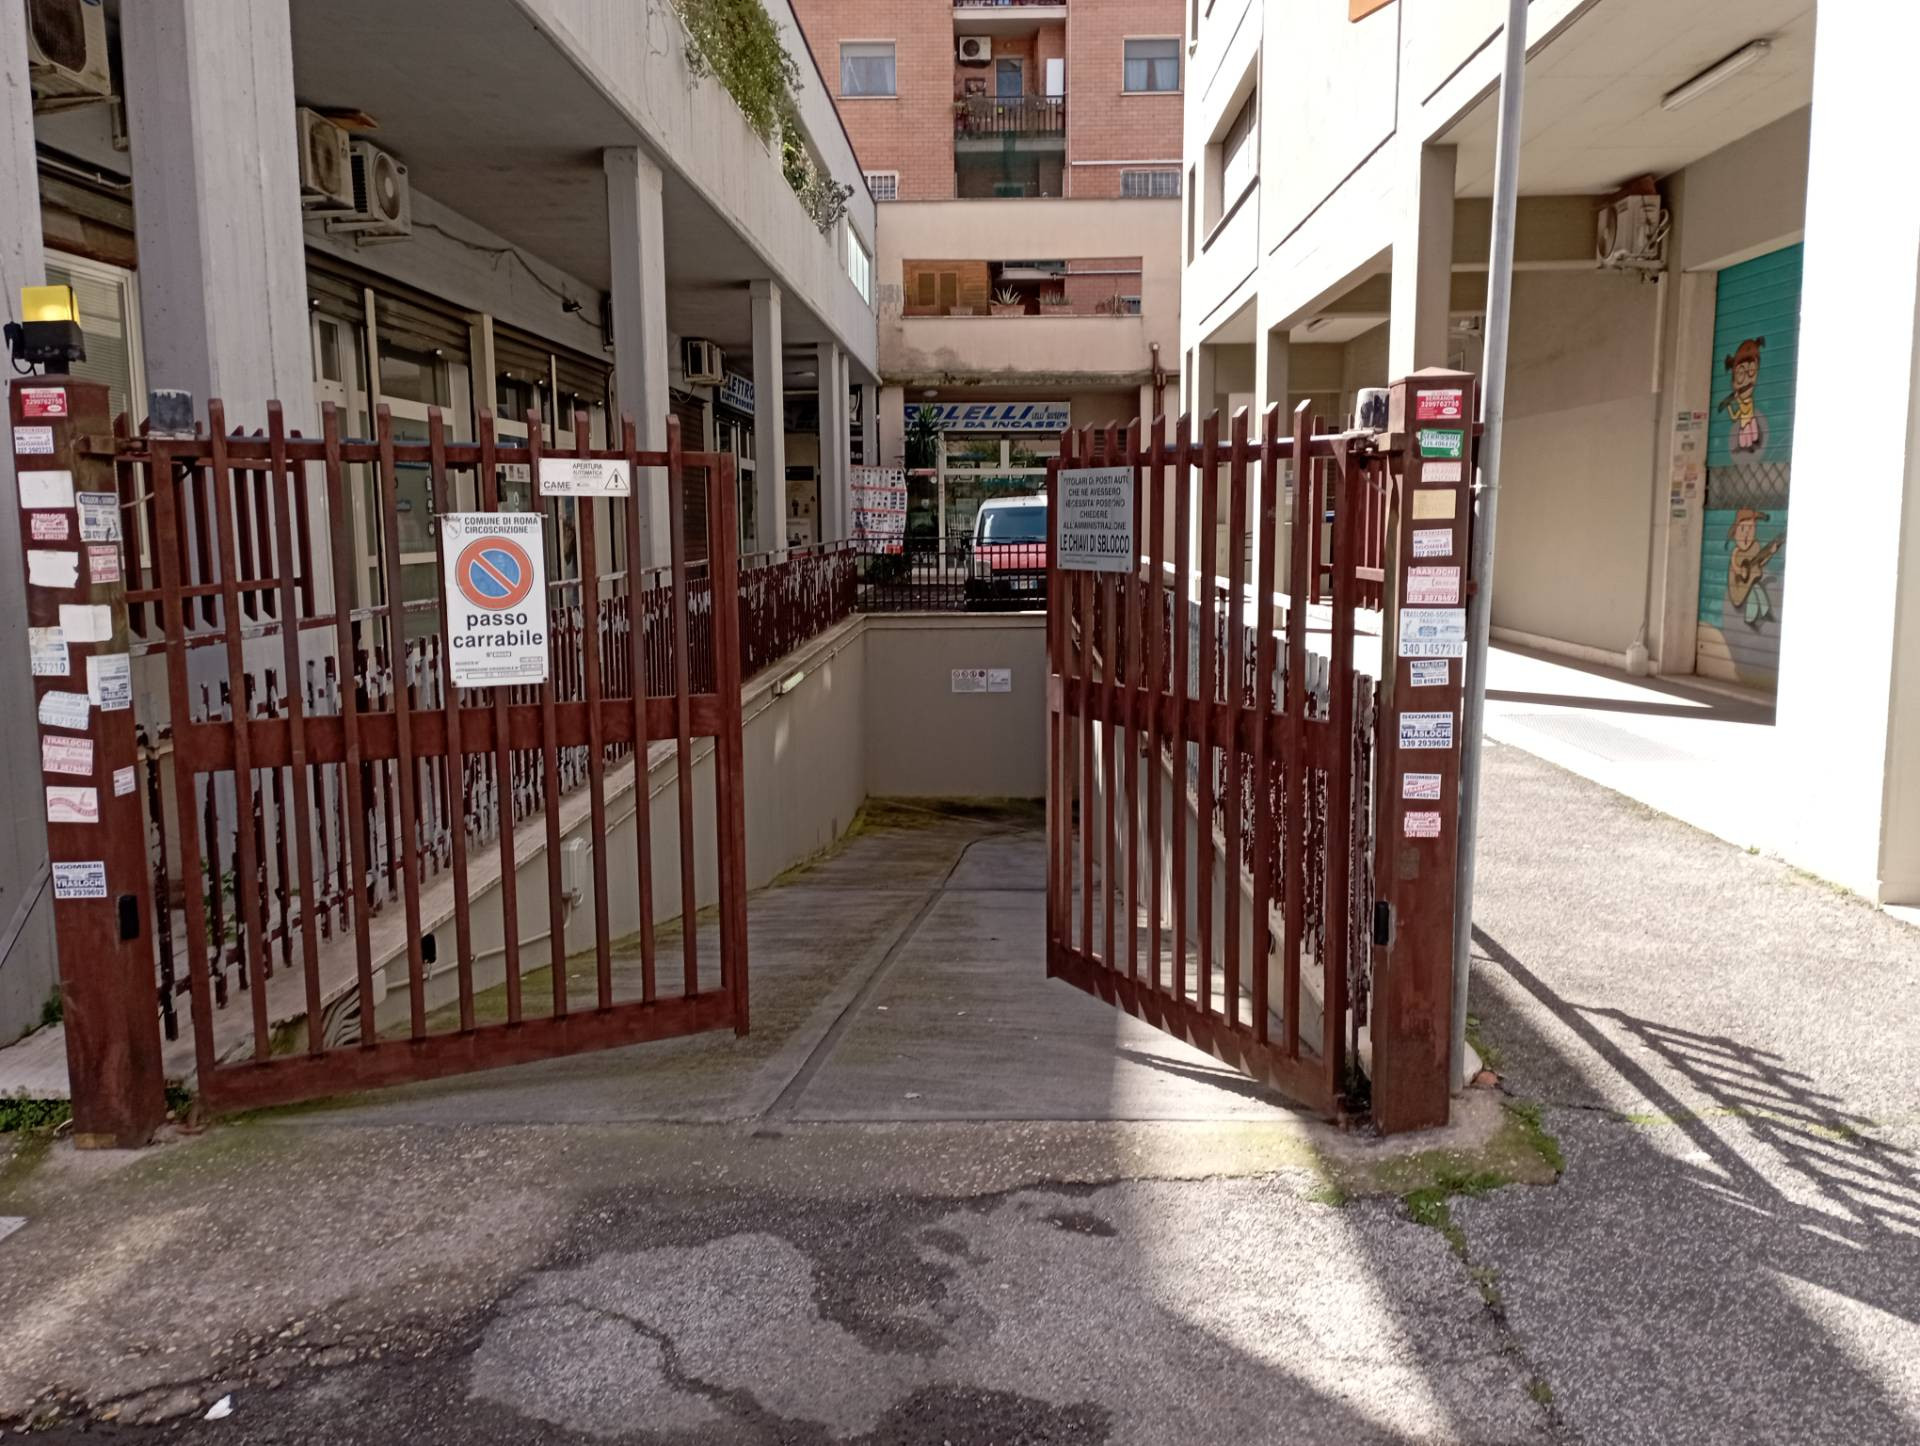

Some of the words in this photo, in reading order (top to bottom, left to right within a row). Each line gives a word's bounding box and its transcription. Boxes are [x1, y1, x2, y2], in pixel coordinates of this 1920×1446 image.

[964, 420, 986, 429] DA
[992, 420, 1068, 429] INCASSO
[572, 462, 603, 470] APERTURA
[1096, 475, 1113, 485] POSTI
[543, 480, 571, 490] CAME
[1068, 488, 1079, 497] CHE
[1090, 486, 1122, 497] AVESSERO
[1079, 510, 1108, 519] CHIEDERE
[464, 516, 502, 526] COMUNE
[503, 517, 512, 526] DI
[513, 516, 539, 526] ROMA
[1063, 521, 1127, 530] ALL'AMMINISTRAZIONE
[464, 525, 529, 534] CIRCOSCRIZIONE
[1060, 533, 1068, 552] LE
[1068, 533, 1089, 552] CHIAVI
[1089, 533, 1096, 553] DI
[1097, 534, 1130, 554] SBLOCCO
[466, 612, 528, 630] passo
[453, 630, 543, 649] carrabile
[1403, 643, 1420, 655] 340
[1424, 643, 1463, 655] 1457210
[1402, 730, 1451, 738] TRASLOCHI
[56, 879, 104, 888] TRASLOCHI
[57, 889, 72, 897] 339
